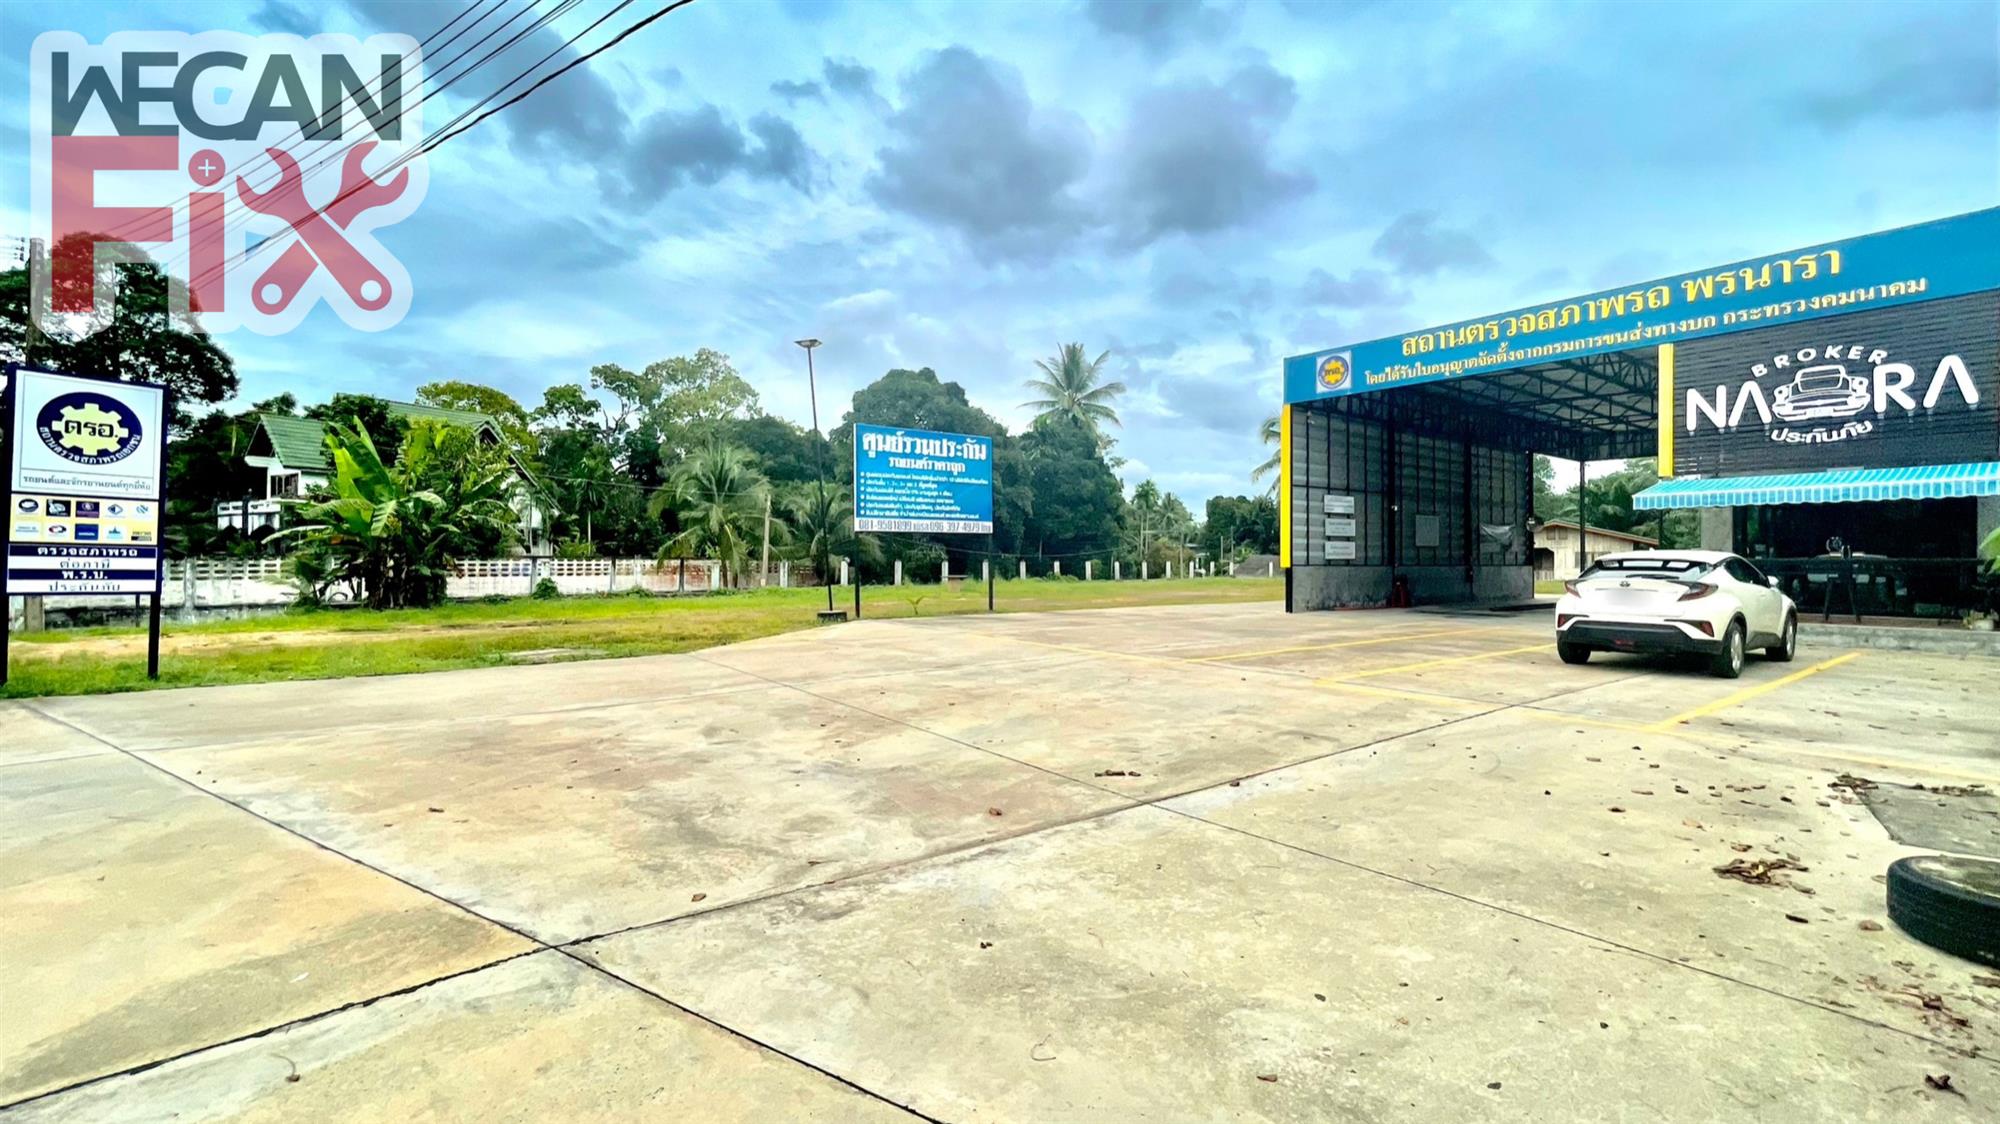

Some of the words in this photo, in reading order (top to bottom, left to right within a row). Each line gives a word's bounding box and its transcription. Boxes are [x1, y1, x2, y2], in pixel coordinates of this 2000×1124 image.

[1401, 284, 1671, 356] สถานตรวจสภาพรถ
[1682, 249, 1841, 301] พรนารา
[1723, 277, 1927, 325] กระทรวงคมนาคม
[1751, 345, 1889, 378] BROKER
[64, 420, 119, 438] ตรอ.
[1770, 420, 1873, 443] ประกันภัย
[862, 431, 987, 460] ศูนย์รวมประกัน
[37, 546, 138, 557] ตรวจสภาพรถ
[62, 570, 108, 580] พ.ร.บ.
